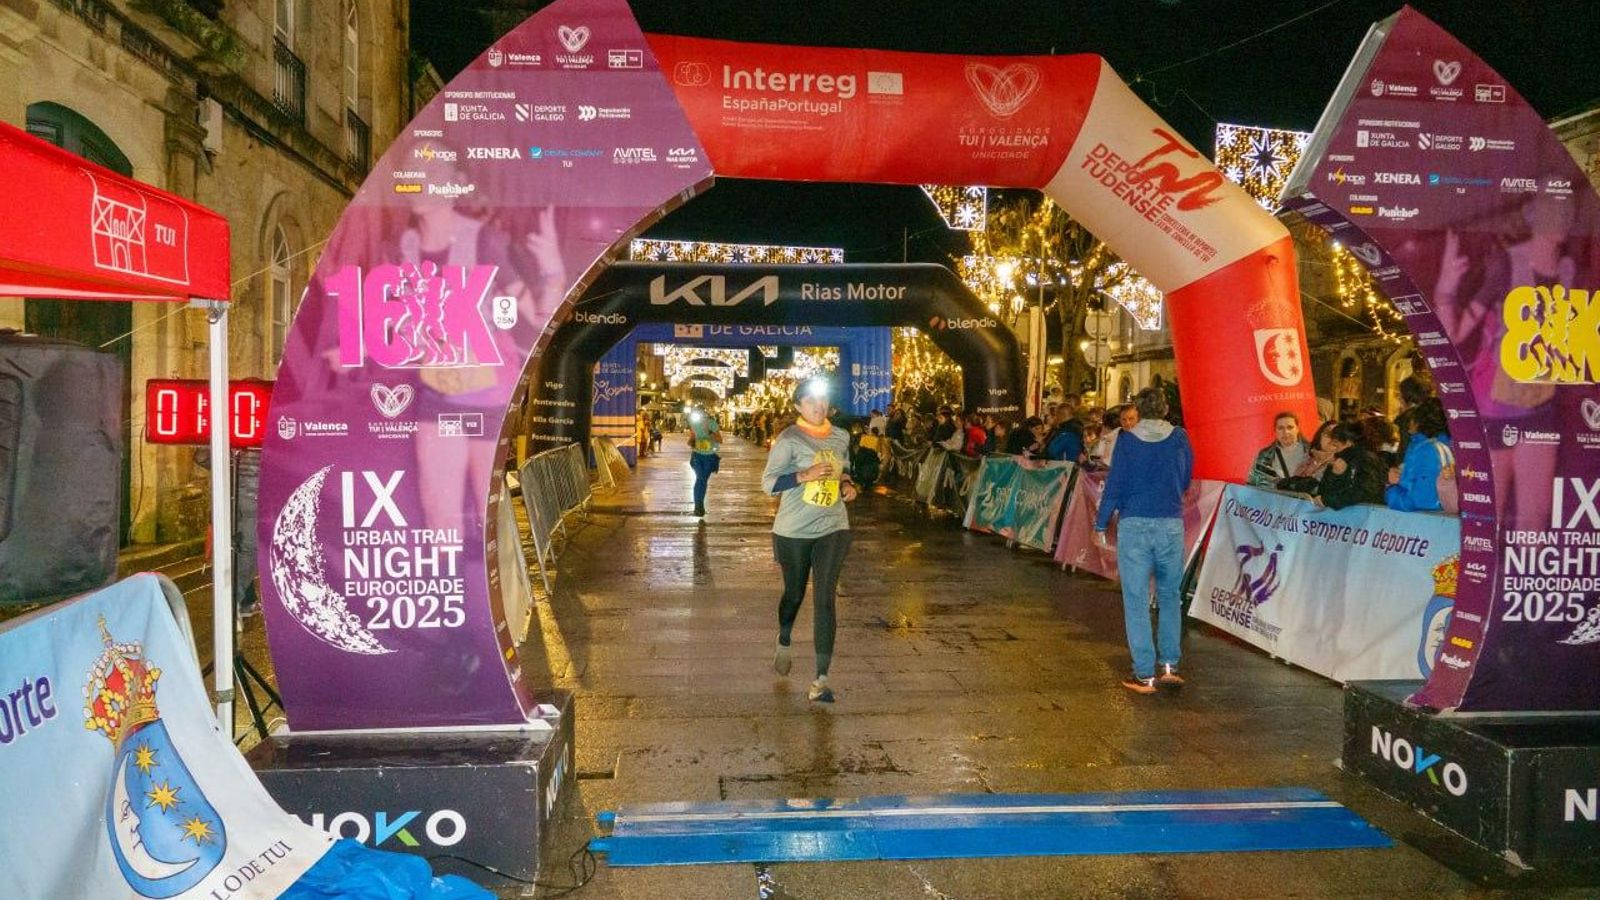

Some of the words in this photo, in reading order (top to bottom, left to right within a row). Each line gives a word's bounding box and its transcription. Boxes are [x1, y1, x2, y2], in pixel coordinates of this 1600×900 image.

[723, 65, 856, 98] Interreg
[534, 105, 566, 113] DEPORTE
[723, 96, 841, 115] EspañaPortugal
[534, 113, 565, 121] GALEGO
[959, 135, 979, 146] TUI
[989, 135, 1049, 149] VALENÇA
[467, 148, 521, 159] XENERA
[613, 148, 656, 158] AVATEL
[972, 151, 1030, 159] UNICIDADE
[1091, 143, 1174, 211] DEPORTE
[1374, 173, 1421, 184] XENERA
[1500, 178, 1538, 188] AVATEL
[1081, 155, 1162, 222] TUDENSE
[154, 223, 177, 247] TUI
[650, 274, 780, 307] KIA
[801, 283, 842, 300] Rias
[848, 283, 907, 300] Motor
[575, 312, 627, 325] blendio
[947, 317, 998, 329] blendio
[739, 324, 813, 336] GALICIA
[545, 381, 564, 391] Vigo
[989, 388, 1007, 396] Vigo
[305, 422, 349, 433] Valença
[341, 470, 408, 527] IX
[1551, 477, 1600, 529] IX
[343, 530, 406, 546] URBAN
[412, 529, 464, 544] TRAIL
[1302, 519, 1352, 543] sempre
[1354, 528, 1368, 546] co
[1371, 528, 1430, 557] deporte
[1505, 531, 1558, 545] URBAN
[344, 546, 463, 579] NIGHT
[1504, 546, 1600, 575] NIGHT
[345, 579, 465, 597] EUROCIDADE
[1504, 577, 1600, 591] EUROCIDADE
[1211, 587, 1254, 614] DEPORTE
[1502, 592, 1585, 622] 2025
[366, 596, 466, 629] 2025
[1210, 599, 1252, 629] TUDENSE
[1371, 726, 1468, 796] NOKO
[1564, 788, 1597, 821] N
[238, 860, 266, 881] DE
[258, 840, 293, 865] TUI
